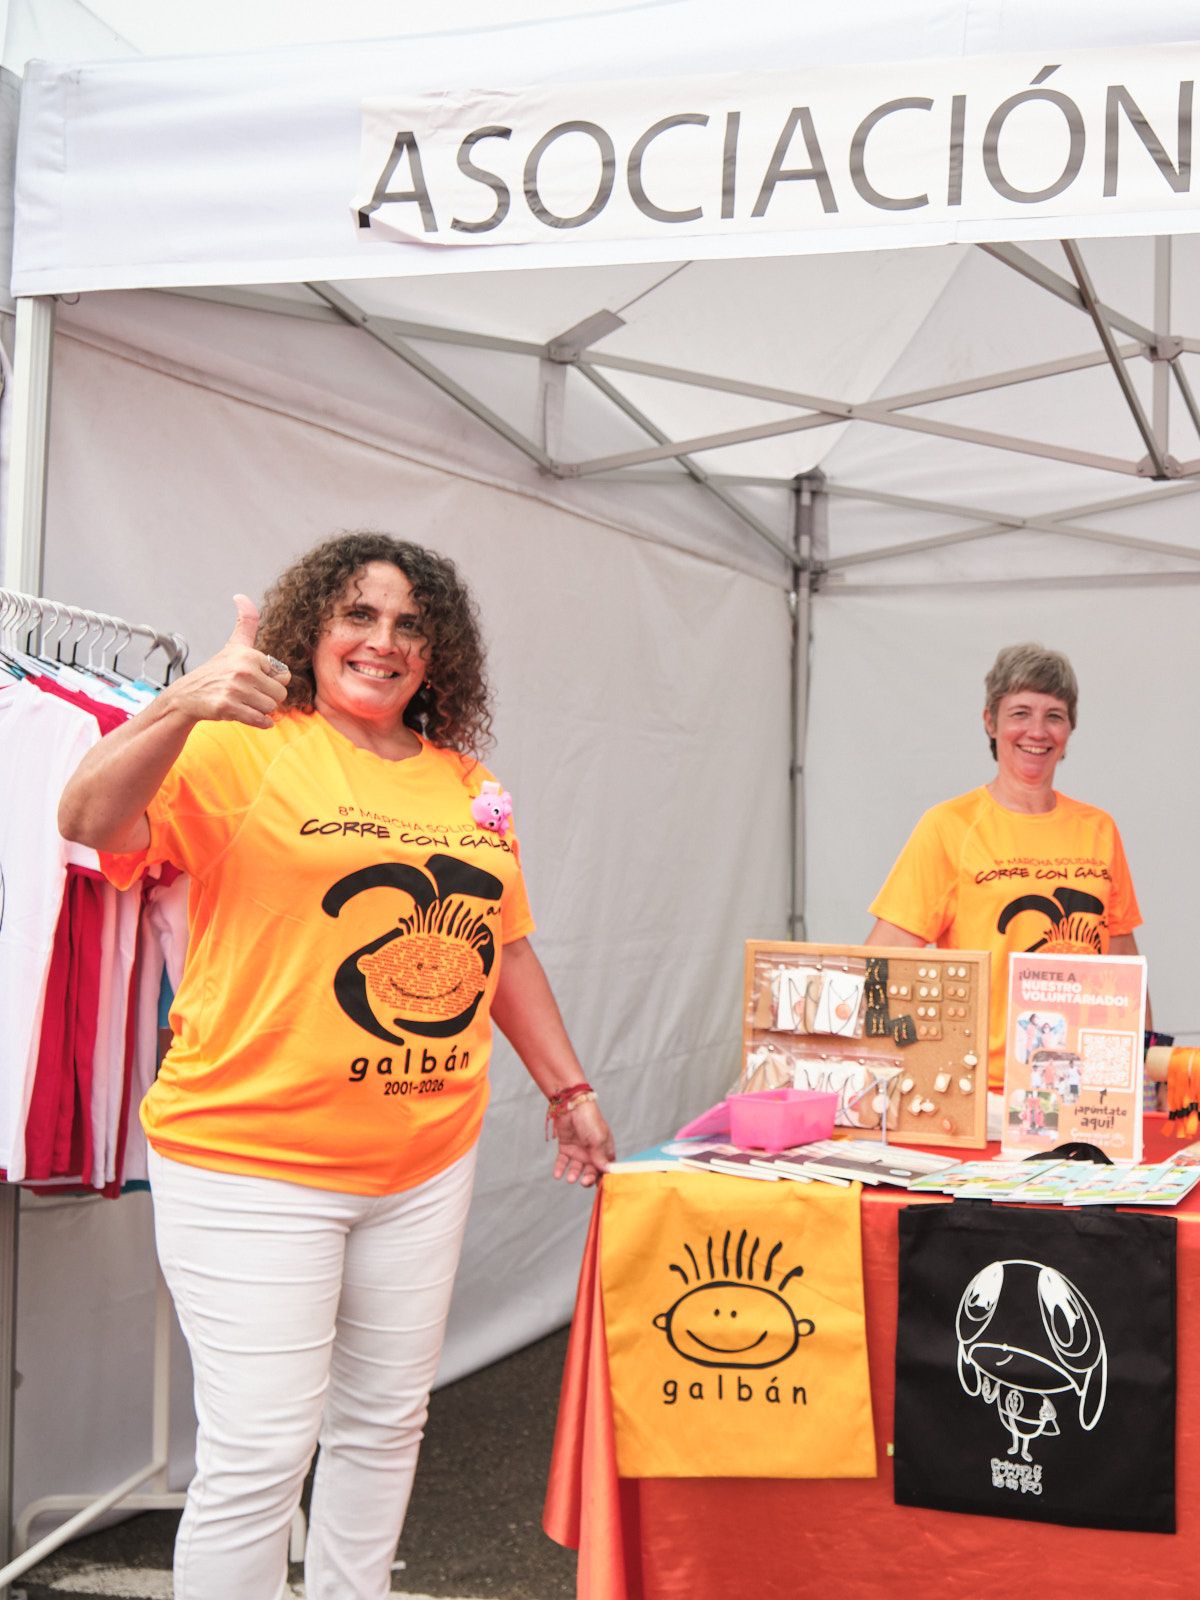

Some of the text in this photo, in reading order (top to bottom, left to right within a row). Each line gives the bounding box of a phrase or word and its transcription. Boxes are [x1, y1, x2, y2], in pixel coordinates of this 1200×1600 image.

[358, 64, 1194, 233] ASOCIACIÓN
[299, 819, 513, 853] CORRE CON GALB
[975, 867, 1029, 885] CORRE
[1035, 868, 1068, 881] CON
[1019, 968, 1076, 982] ¡ÚNETE A
[1022, 980, 1082, 994] NUESTRO
[1022, 991, 1129, 1007] VOLUNTARIADO!
[348, 1045, 470, 1082] galbán
[384, 1080, 444, 1096] 2001-2026
[1074, 1104, 1128, 1117] ¡apúntate
[1080, 1116, 1115, 1130] aquí!
[663, 1374, 808, 1405] galbán
